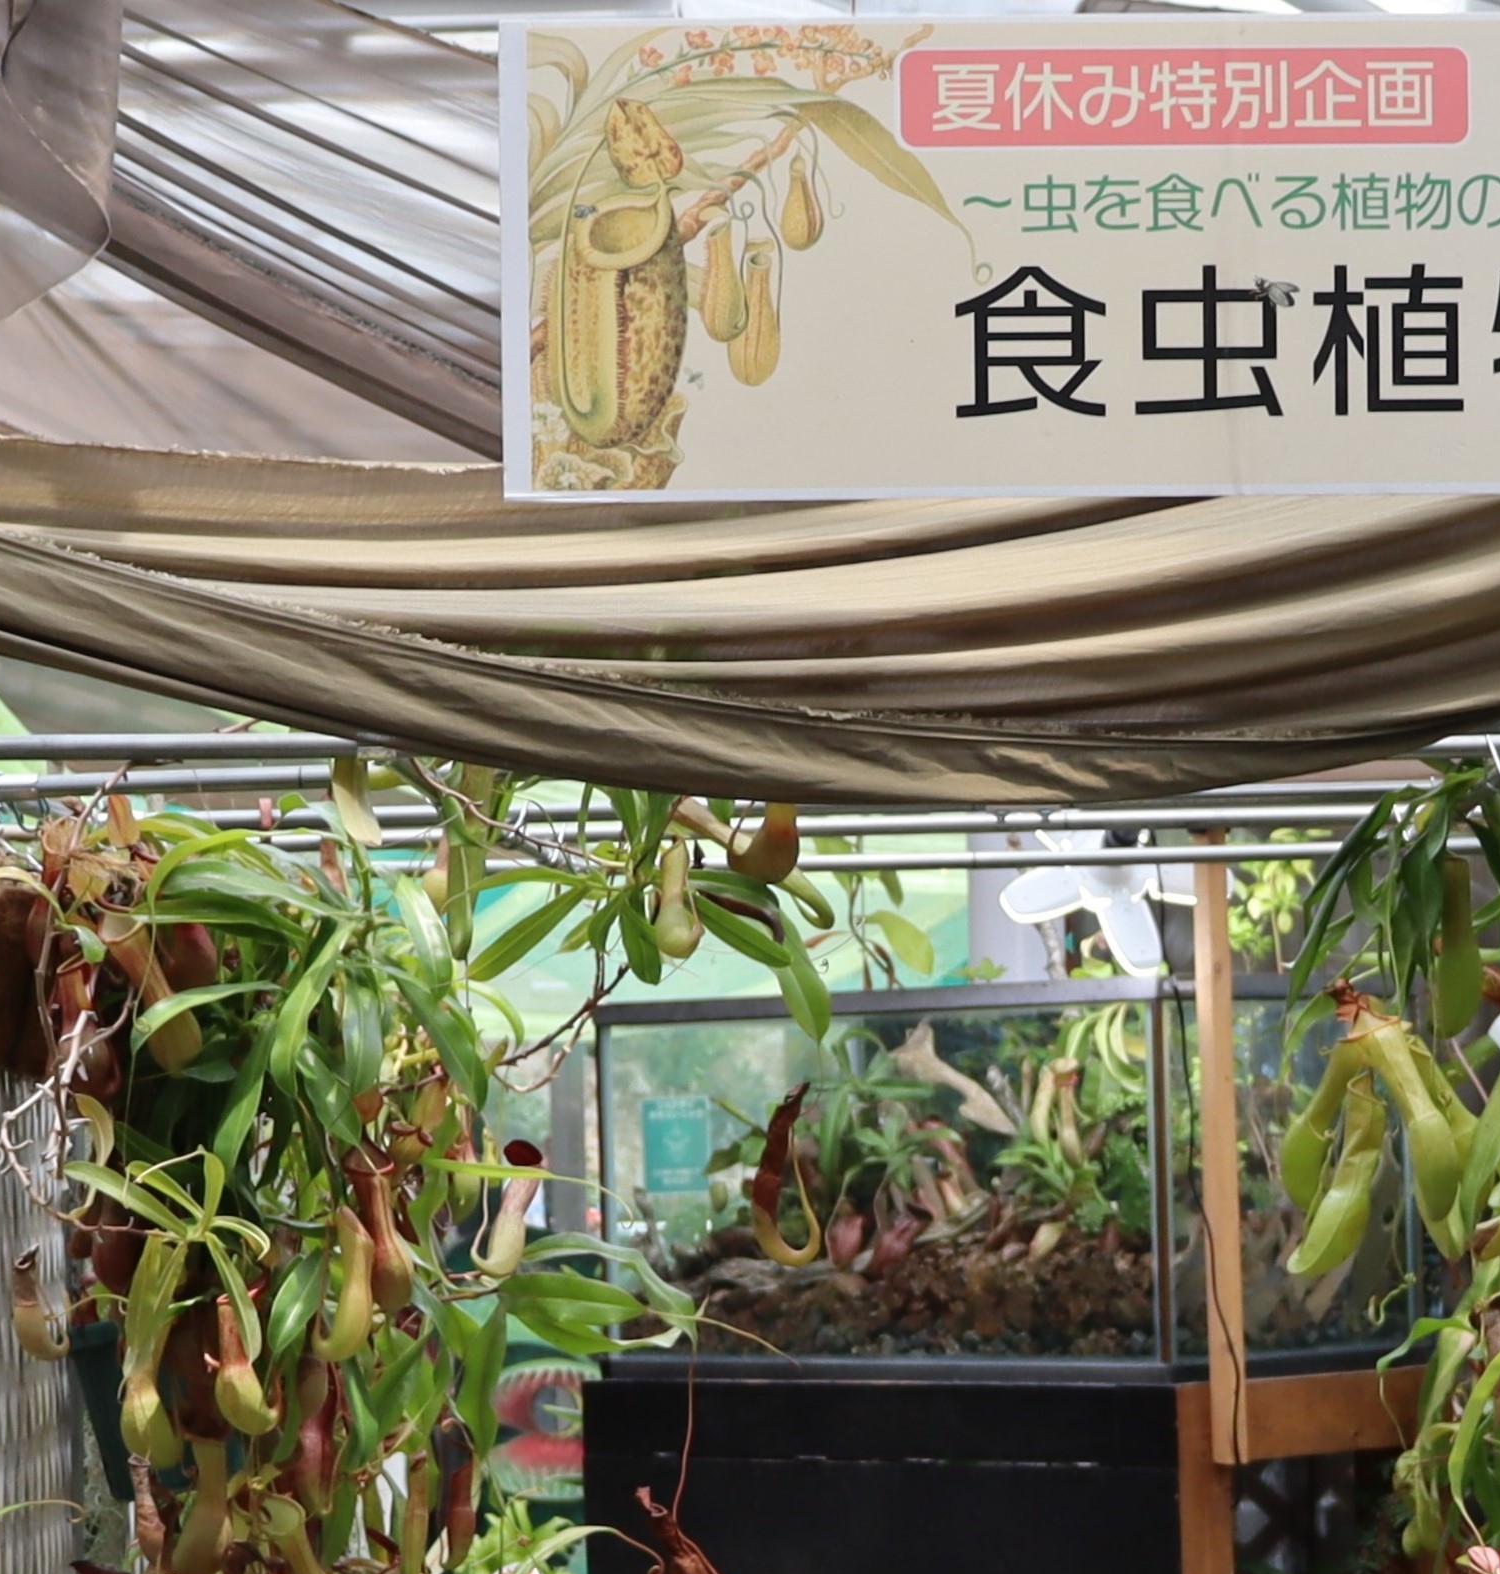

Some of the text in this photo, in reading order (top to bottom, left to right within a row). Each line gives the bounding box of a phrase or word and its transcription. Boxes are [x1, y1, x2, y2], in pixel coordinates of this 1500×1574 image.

[932, 59, 1435, 132] 夏休み特別企画
